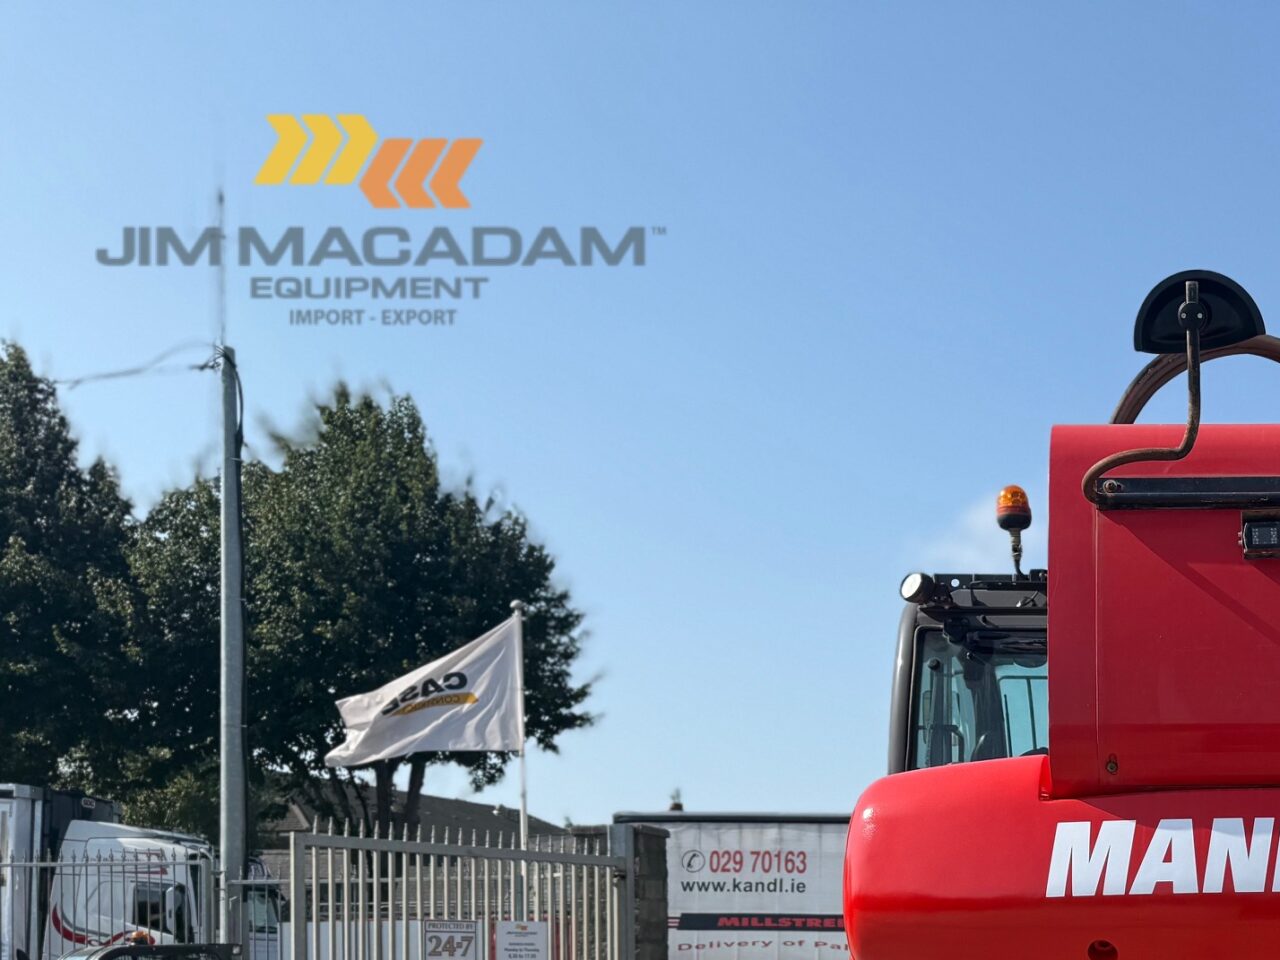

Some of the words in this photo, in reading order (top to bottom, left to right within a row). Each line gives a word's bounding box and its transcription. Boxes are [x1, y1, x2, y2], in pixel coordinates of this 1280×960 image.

[709, 850, 744, 873] 029
[750, 851, 807, 873] 70163
[681, 878, 806, 893] www.kandl.ie
[428, 922, 464, 930] PROTECTED
[677, 940, 773, 951] Delivery
